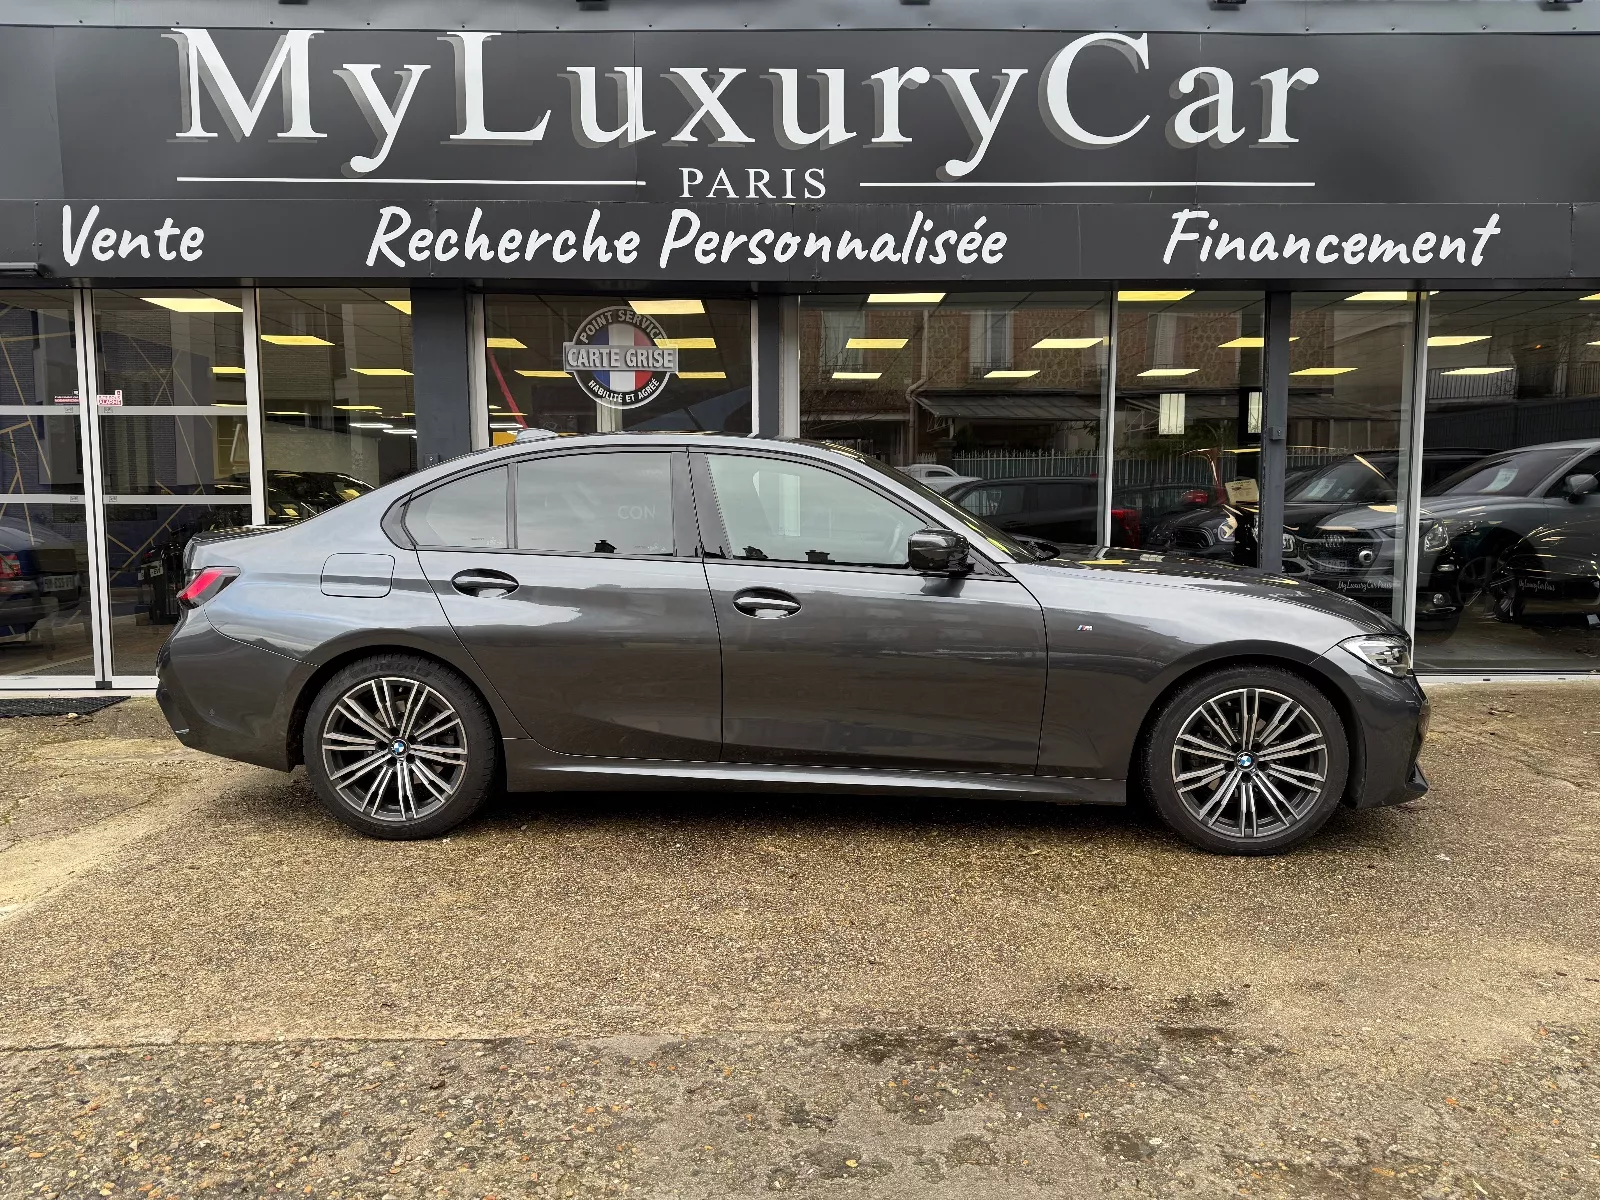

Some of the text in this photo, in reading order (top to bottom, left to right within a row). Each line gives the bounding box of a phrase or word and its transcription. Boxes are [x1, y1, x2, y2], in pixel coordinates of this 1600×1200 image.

[170, 28, 1320, 177] MyLuxuryCar
[679, 167, 826, 199] PARIS
[62, 204, 205, 264] Vente
[365, 205, 1008, 269] Recherche Personnalisée
[1162, 208, 1501, 266] Financement
[579, 310, 613, 344] POINT
[567, 348, 674, 368] CARTE GRISE
[625, 393, 635, 403] ET
